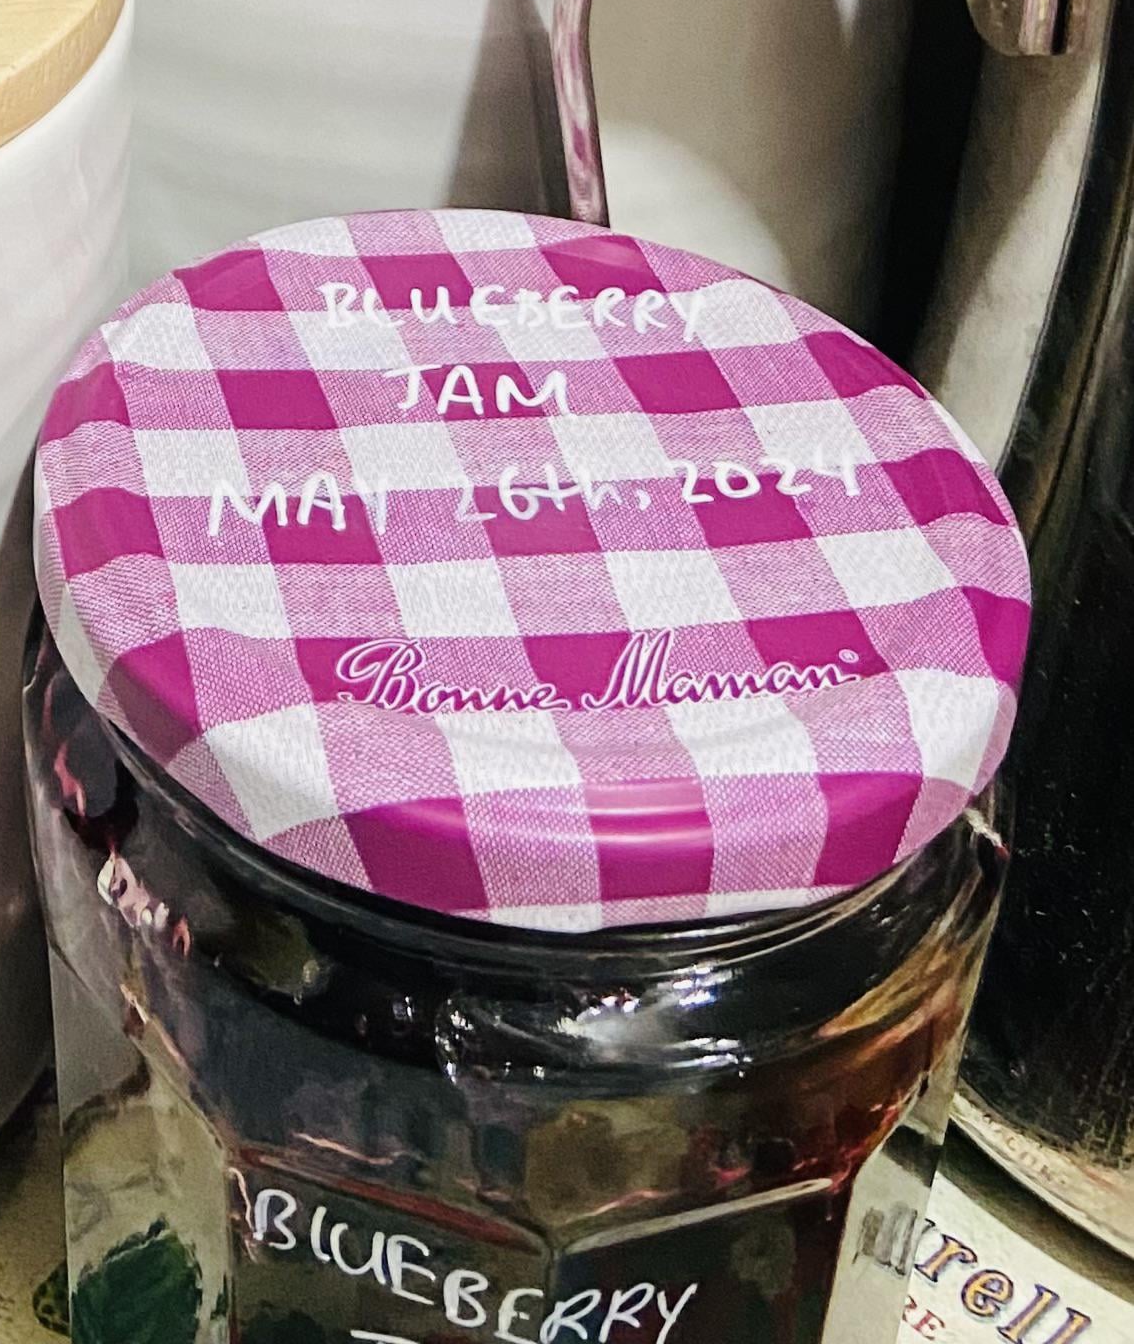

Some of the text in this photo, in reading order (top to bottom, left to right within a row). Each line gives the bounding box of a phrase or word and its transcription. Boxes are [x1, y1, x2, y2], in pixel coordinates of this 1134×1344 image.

[318, 281, 706, 343] BLUEBERRY
[385, 363, 570, 418] JAM
[206, 469, 390, 538] MAY
[680, 447, 862, 506] 2024
[336, 626, 862, 714] Bonne Maman
[252, 1188, 698, 1344] BLUEBERRY
